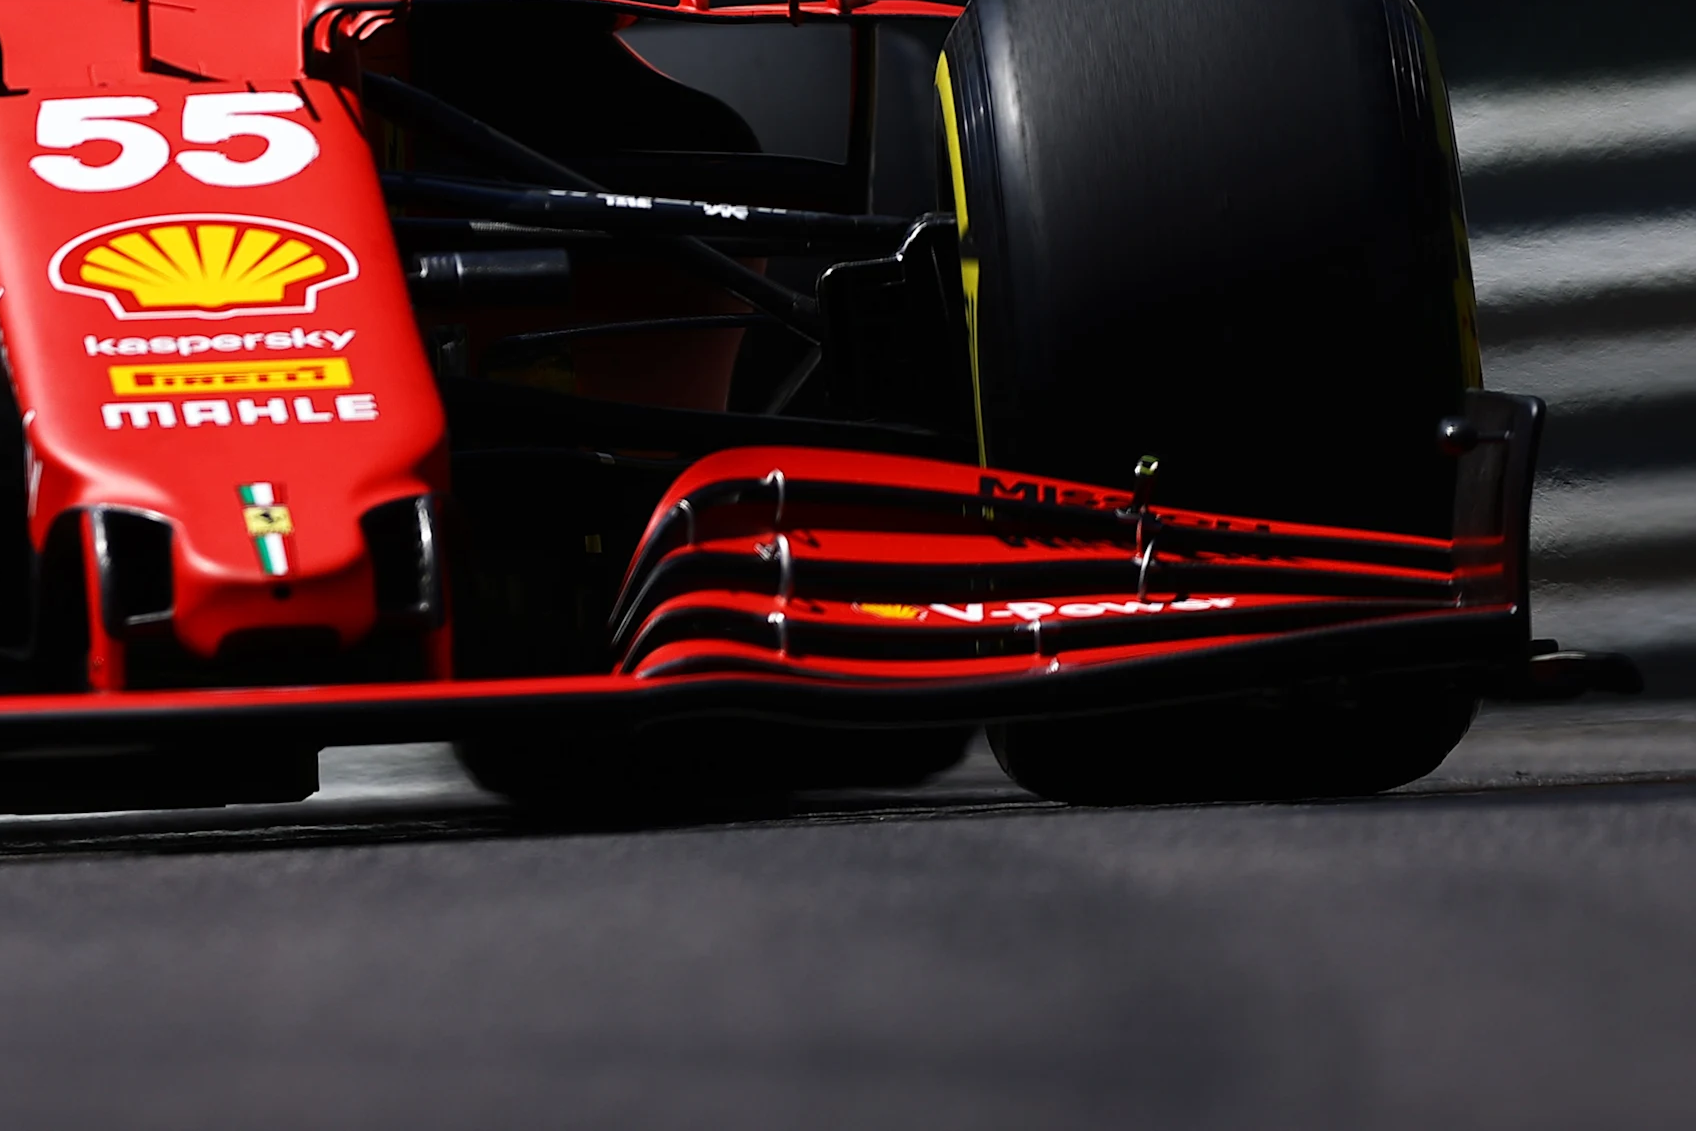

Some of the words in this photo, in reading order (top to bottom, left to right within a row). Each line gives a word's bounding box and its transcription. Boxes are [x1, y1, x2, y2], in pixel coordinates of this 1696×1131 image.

[29, 91, 320, 192] 55
[84, 327, 356, 356] kaspersky
[101, 393, 380, 430] MAHLE
